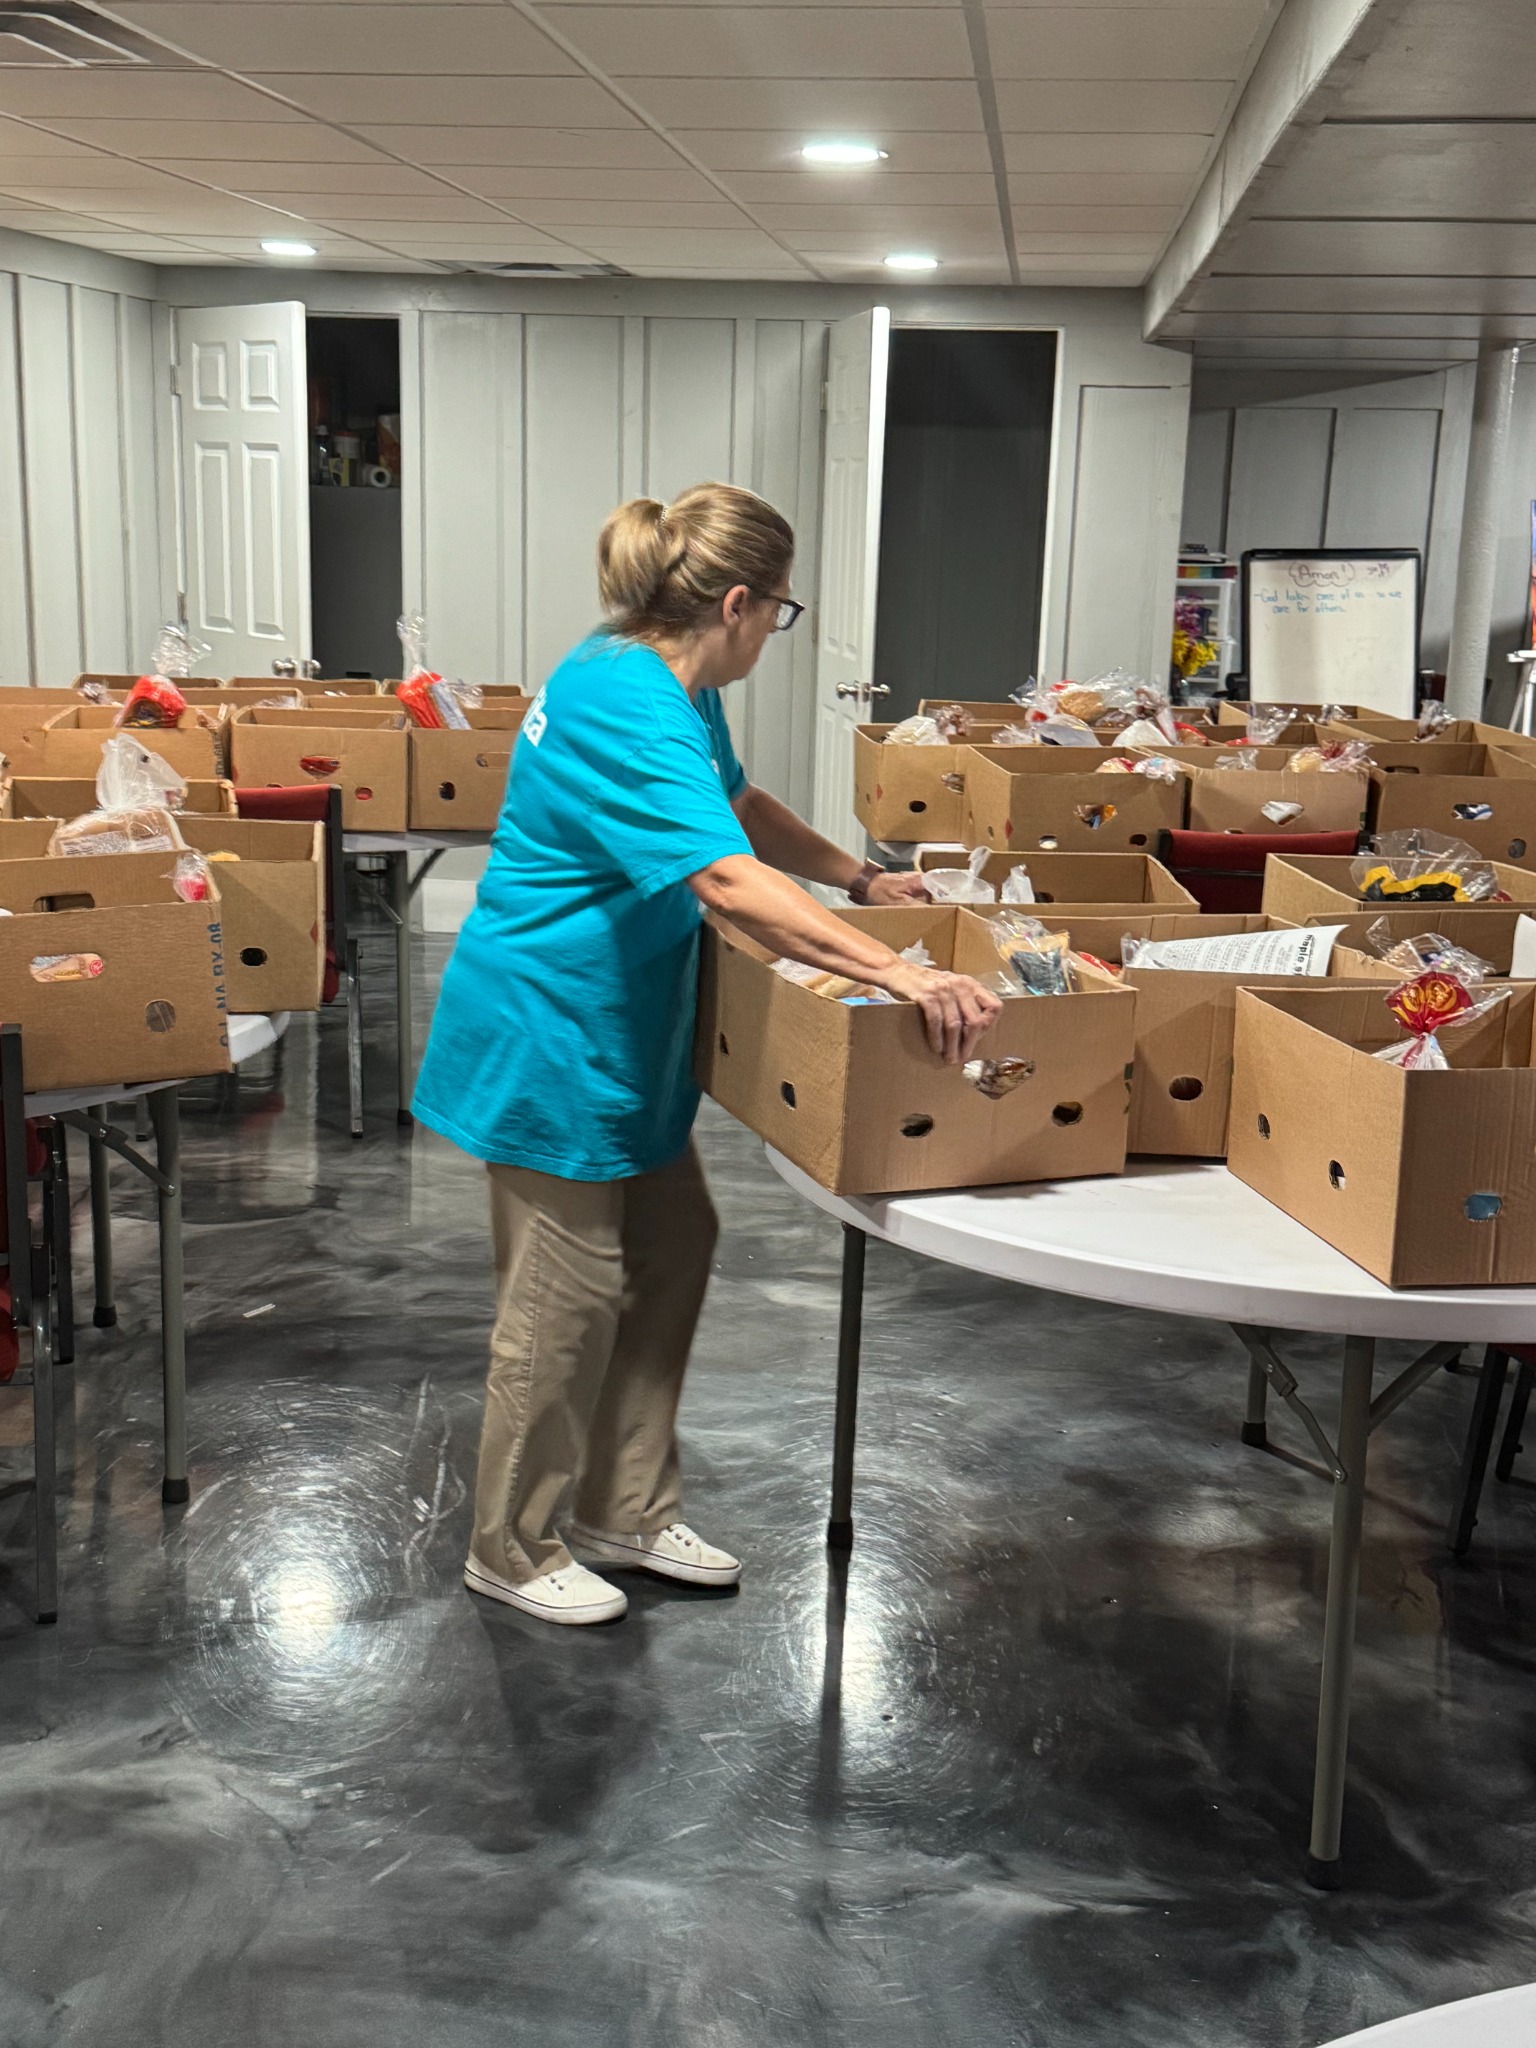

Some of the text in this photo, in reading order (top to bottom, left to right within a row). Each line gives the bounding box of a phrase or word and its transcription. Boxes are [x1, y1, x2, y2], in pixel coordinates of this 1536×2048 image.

[1316, 593, 1336, 601] care
[1272, 605, 1290, 614] care
[1296, 601, 1310, 613] for
